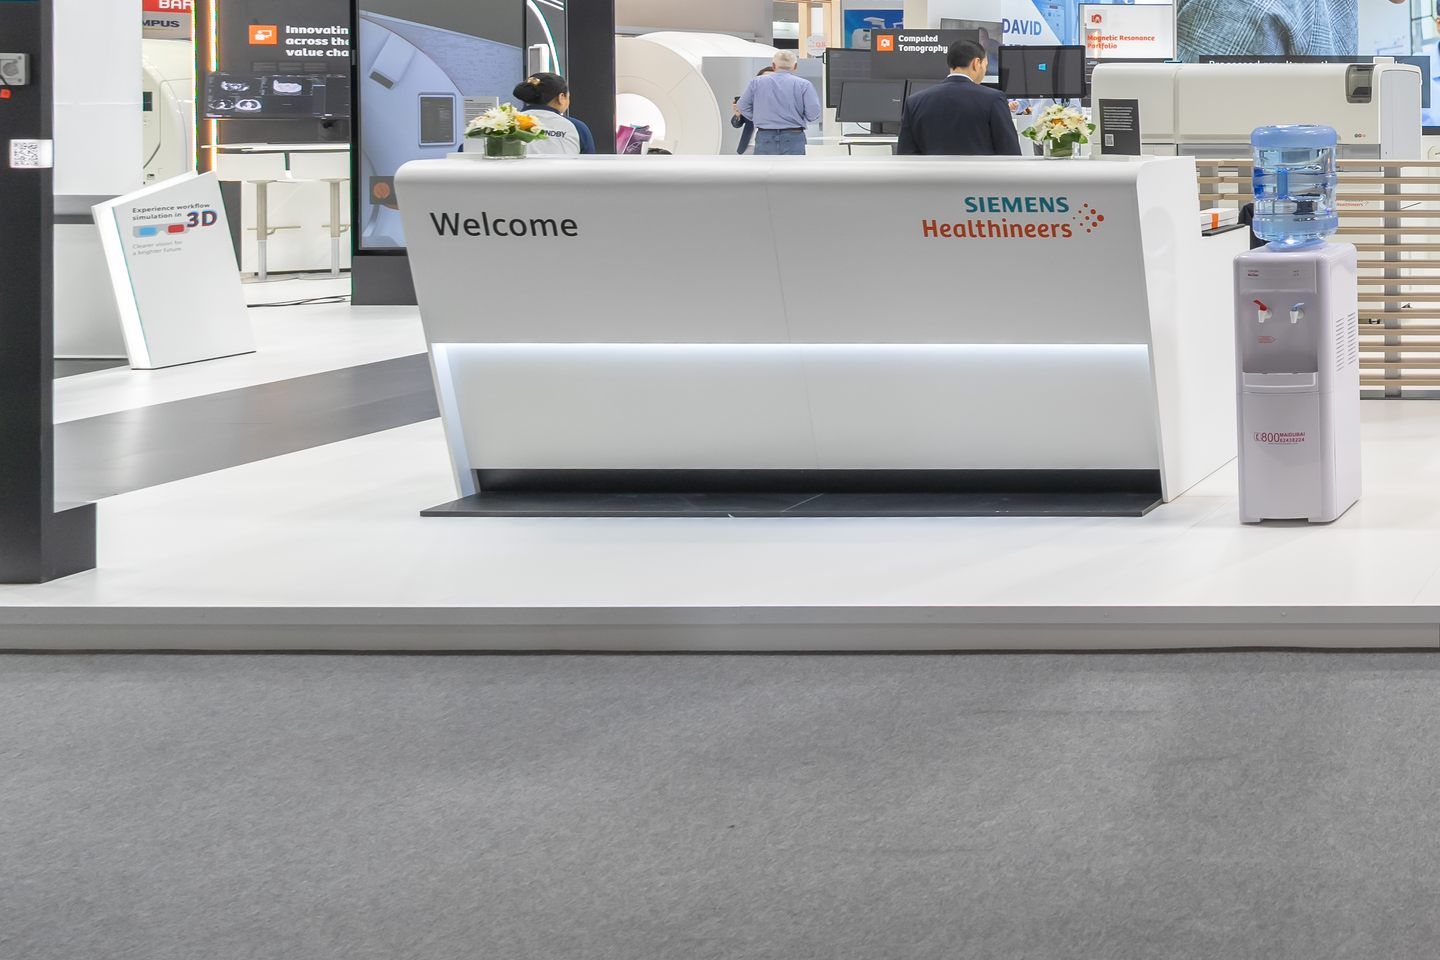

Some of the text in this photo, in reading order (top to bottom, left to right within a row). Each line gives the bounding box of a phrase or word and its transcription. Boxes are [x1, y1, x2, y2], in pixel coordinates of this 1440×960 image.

[142, 19, 180, 28] MPUS
[1002, 18, 1042, 36] DAVID
[286, 25, 349, 35] Innovatin
[286, 38, 329, 46] across
[898, 34, 938, 43] Computed
[1087, 34, 1155, 43] Magnetic Resonance
[286, 48, 349, 57] value cha
[898, 44, 949, 54] Tomography
[545, 130, 567, 138] NDBY
[964, 196, 1070, 213] SIEMENS
[132, 205, 175, 214] Experience
[132, 212, 173, 221] simulation
[186, 210, 218, 228] 3D
[430, 211, 578, 237] Welcome
[922, 216, 1073, 238] Healthineers
[1261, 432, 1280, 443] 800
